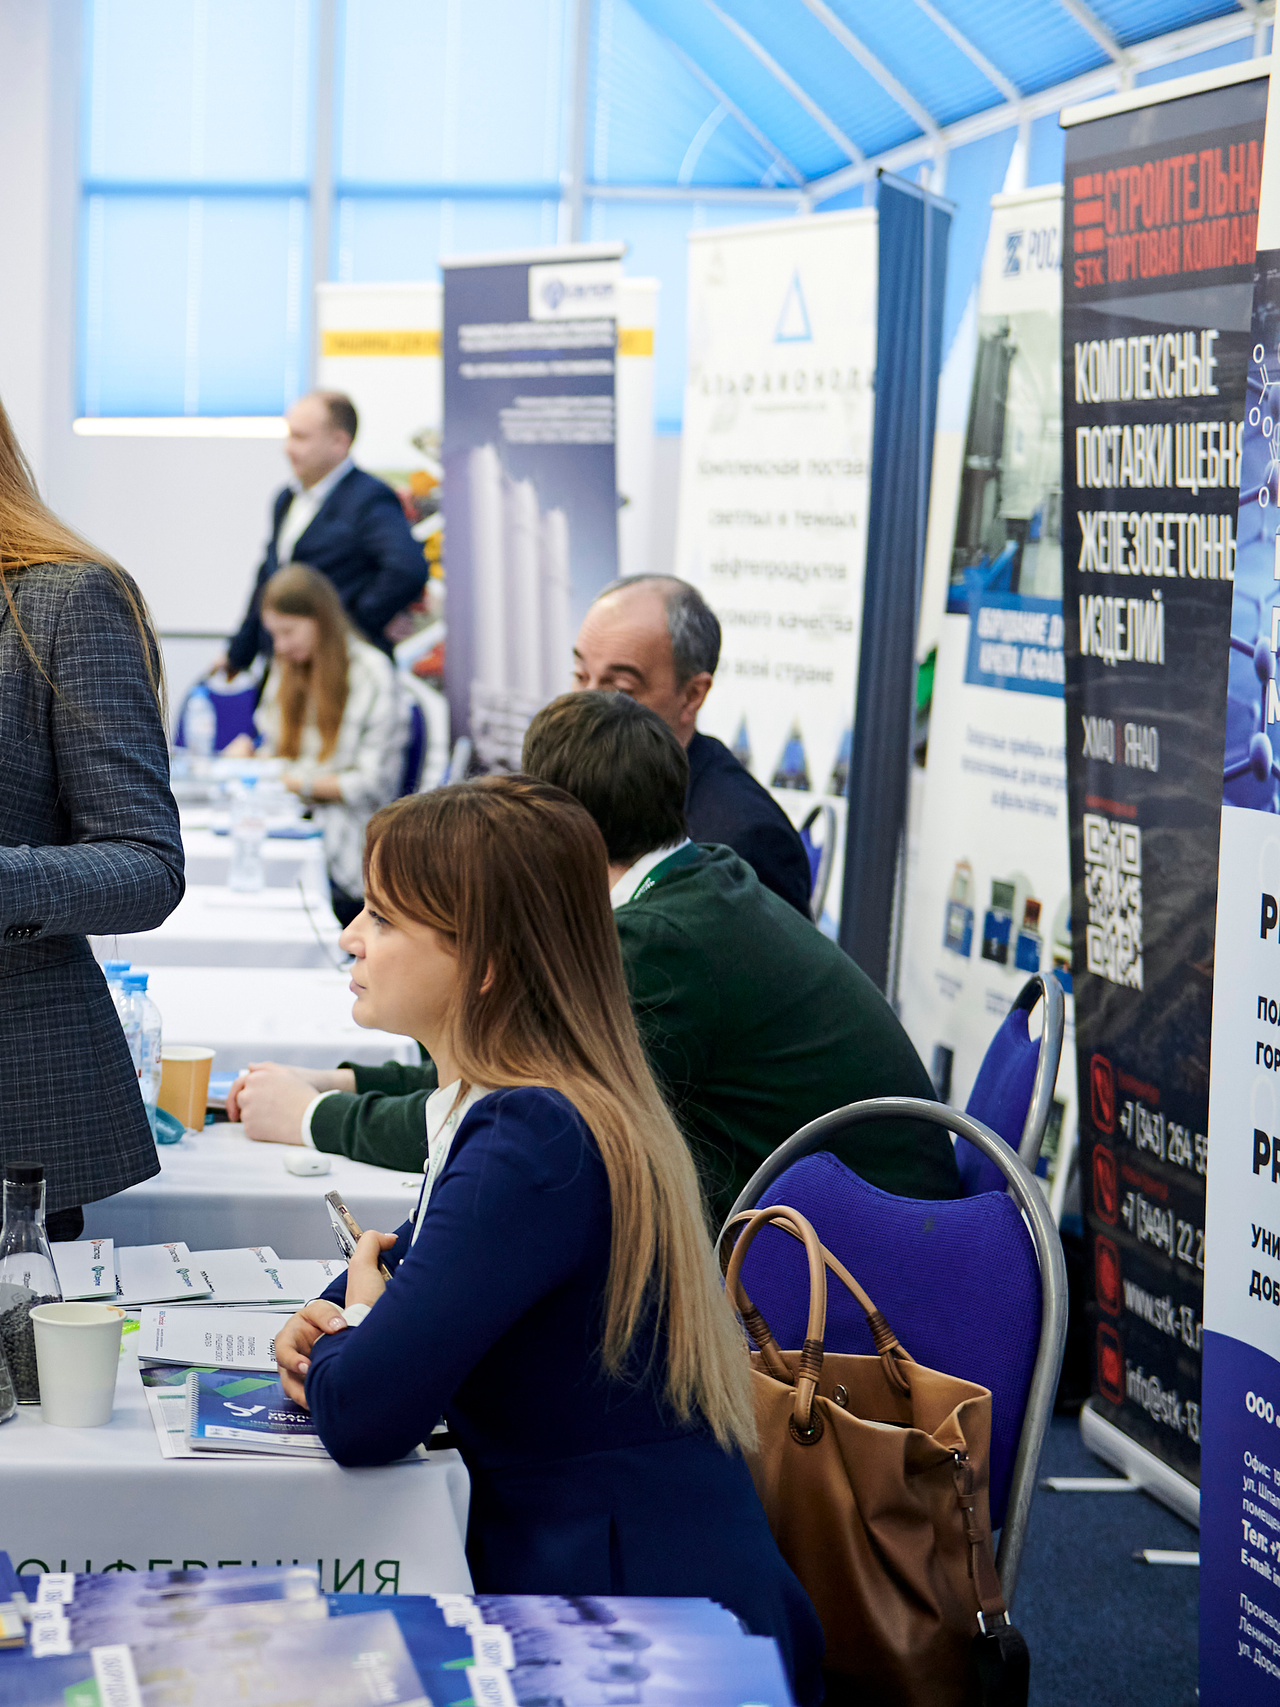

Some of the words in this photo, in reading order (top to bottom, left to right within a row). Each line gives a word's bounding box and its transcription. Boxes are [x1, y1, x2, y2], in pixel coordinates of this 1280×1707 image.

[1104, 140, 1265, 234] СТРОИТЕЛЬНА
[1074, 328, 1220, 404] КОМПЛЕКСНЫЕ
[1076, 422, 1173, 489] ПОСТАВКИ
[1078, 588, 1166, 668] ИЗДЕЛИЙ
[1081, 715, 1116, 765] ХМАО
[1124, 722, 1160, 773] ЯНАО
[1245, 1390, 1274, 1424] ООО
